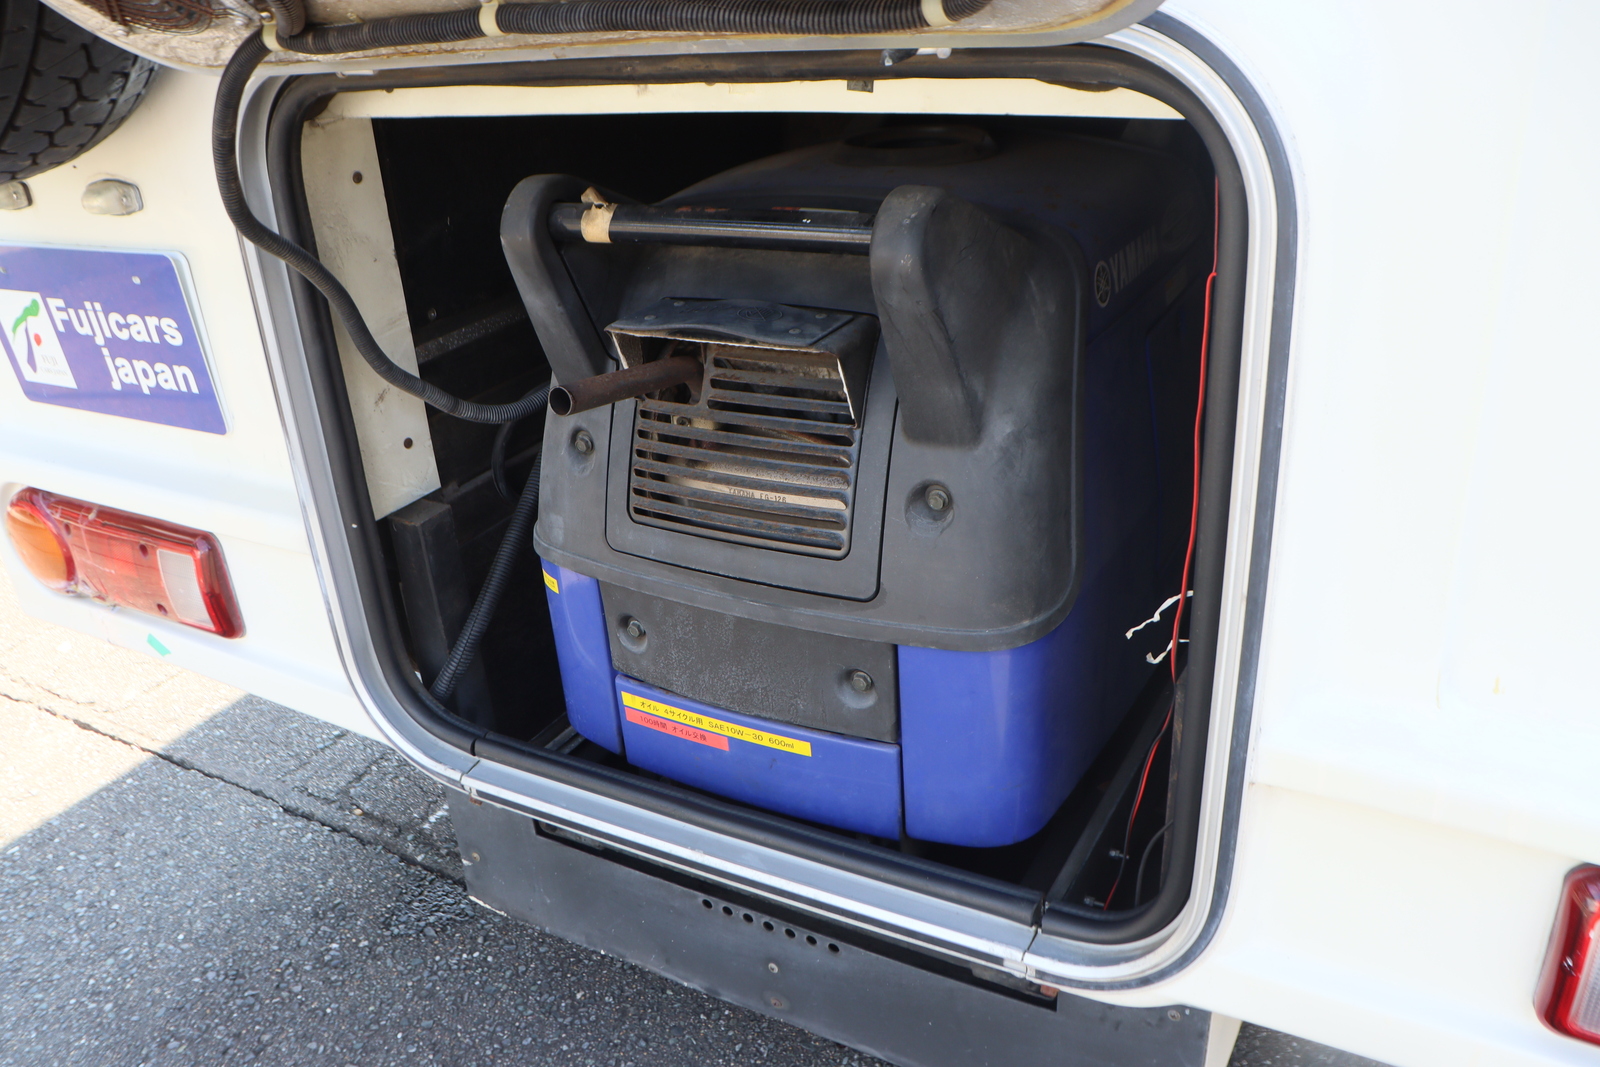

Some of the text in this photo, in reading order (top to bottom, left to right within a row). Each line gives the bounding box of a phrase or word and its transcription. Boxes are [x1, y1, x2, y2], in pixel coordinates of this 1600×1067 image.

[46, 297, 183, 346] Fujicars
[101, 347, 199, 395] japan
[640, 701, 660, 712] オイル
[664, 708, 704, 726] 4サイクル用
[768, 737, 795, 749] 600ml
[640, 715, 708, 743] 100時間 オイル交換
